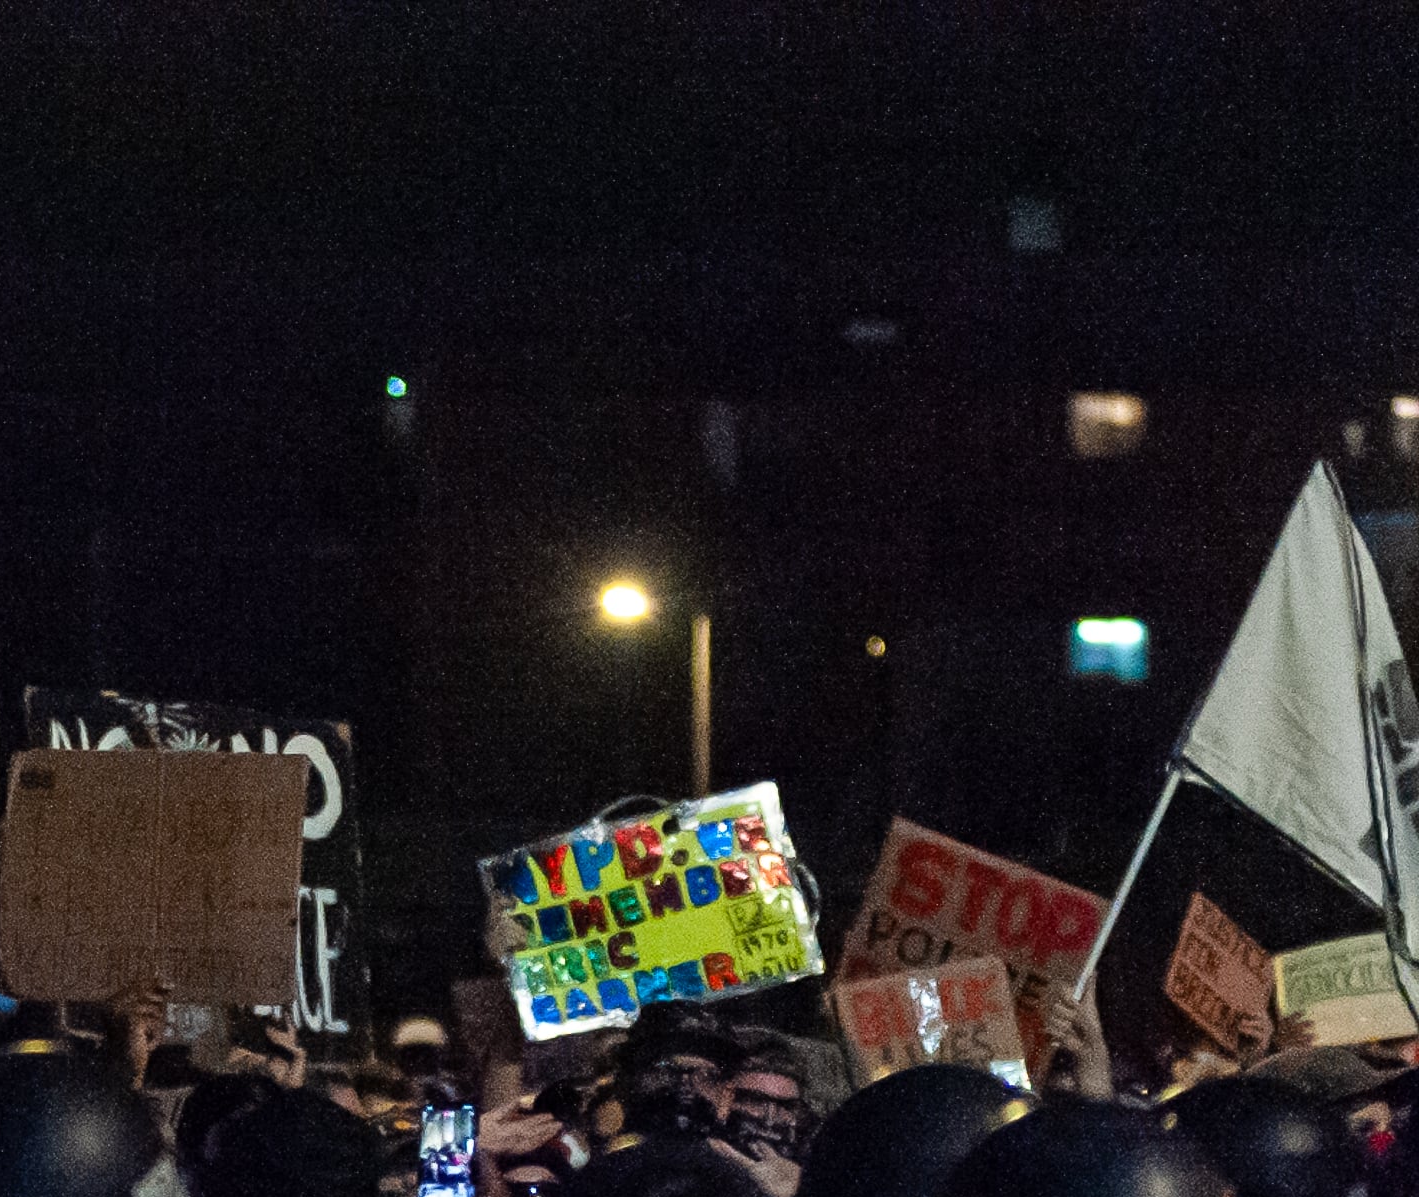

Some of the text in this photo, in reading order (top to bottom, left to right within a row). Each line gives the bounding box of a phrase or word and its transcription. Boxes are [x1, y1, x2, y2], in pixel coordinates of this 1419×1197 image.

[890, 840, 1102, 968] STOP
[519, 931, 640, 995] ERIC
[853, 974, 999, 1047] BLCK
